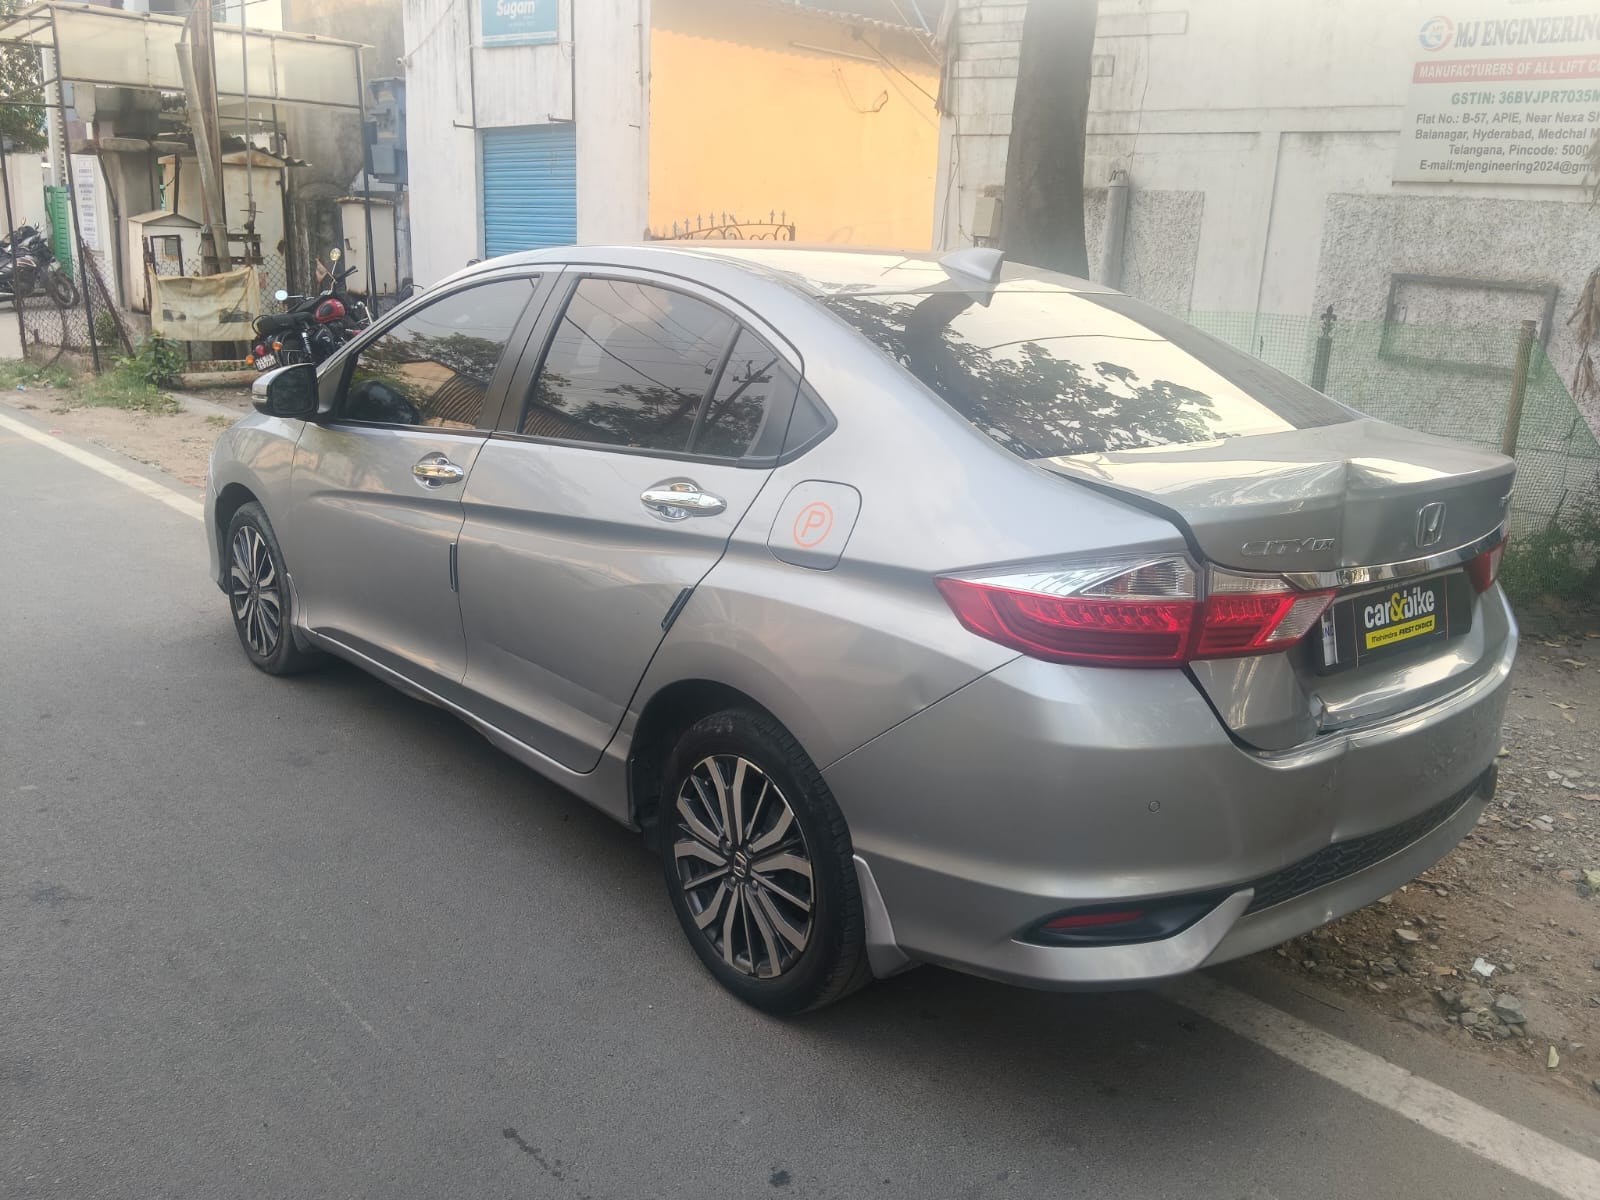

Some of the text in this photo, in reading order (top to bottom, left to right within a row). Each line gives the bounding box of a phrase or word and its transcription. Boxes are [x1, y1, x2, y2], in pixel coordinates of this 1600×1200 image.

[495, 0, 535, 19] Sugam
[1454, 21, 1481, 48] MJ
[1419, 62, 1513, 78] MANUFACTURERS
[1517, 62, 1533, 75] OF
[1534, 61, 1555, 74] ALL
[1559, 59, 1585, 73] LIFT
[1451, 92, 1495, 105] GSTIN:
[1416, 113, 1435, 124] Flat
[1462, 112, 1489, 124] B-57,
[1492, 112, 1522, 125] APIE,
[1525, 112, 1552, 123] Near
[1555, 112, 1585, 122] Nexa
[1415, 128, 1469, 141] Balanagar,
[1472, 127, 1534, 141] Hyderabad,
[1537, 127, 1588, 139] Medchal
[1449, 144, 1505, 157] Telangana,
[1508, 144, 1558, 156] Pincode:
[800, 509, 826, 538] P
[1371, 619, 1433, 644] Mahindra FIRST CHOICE
